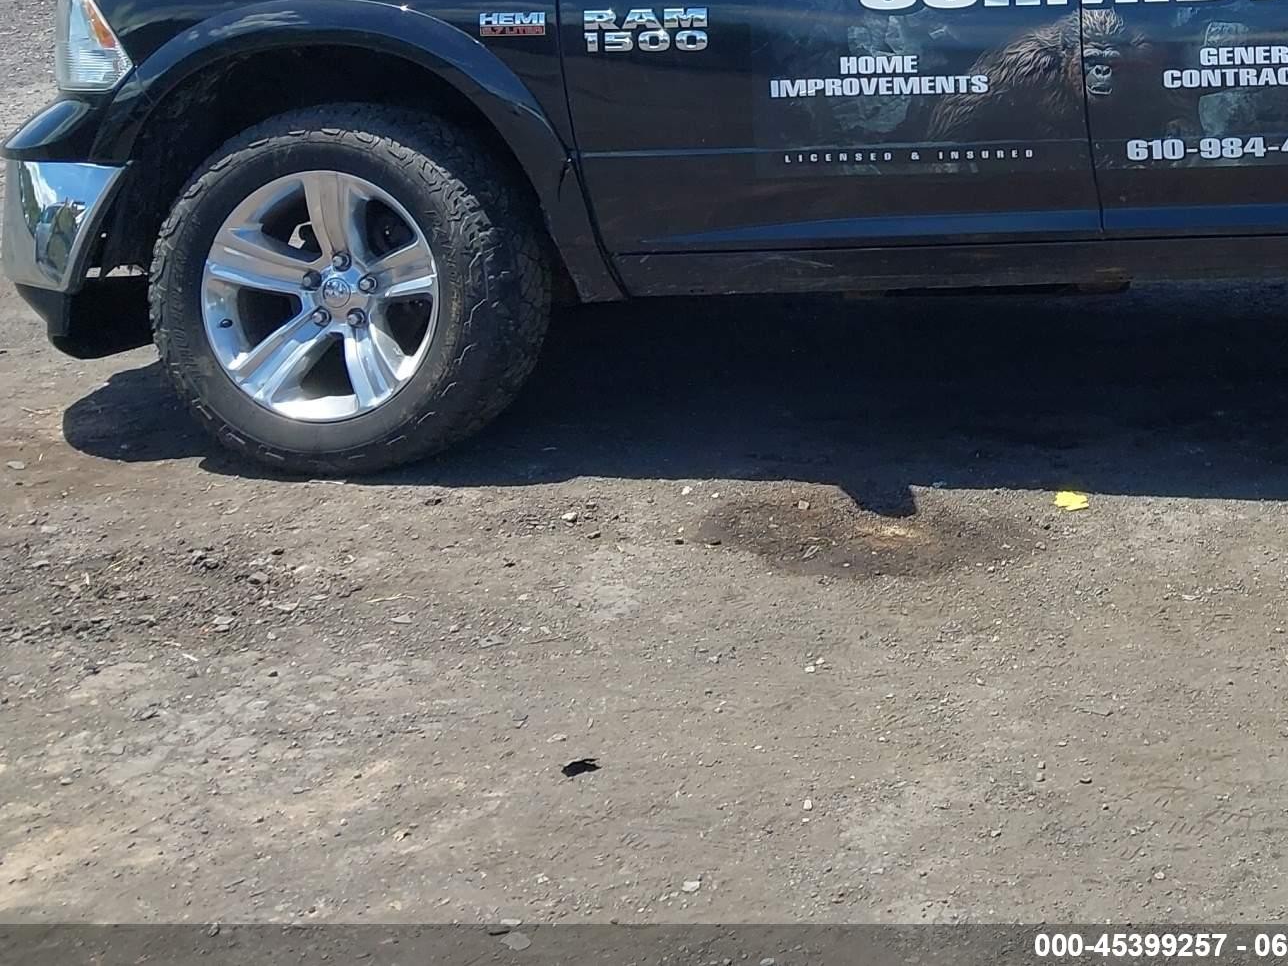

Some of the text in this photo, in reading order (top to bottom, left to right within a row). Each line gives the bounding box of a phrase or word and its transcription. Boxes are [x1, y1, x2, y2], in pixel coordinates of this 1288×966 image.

[480, 12, 545, 25] HEMI
[583, 7, 707, 30] RAM
[584, 30, 708, 52] 1500
[840, 55, 918, 75] HOME
[769, 74, 990, 98] IMPROVEMENTS
[784, 149, 1034, 164] LICENSED & INSURED
